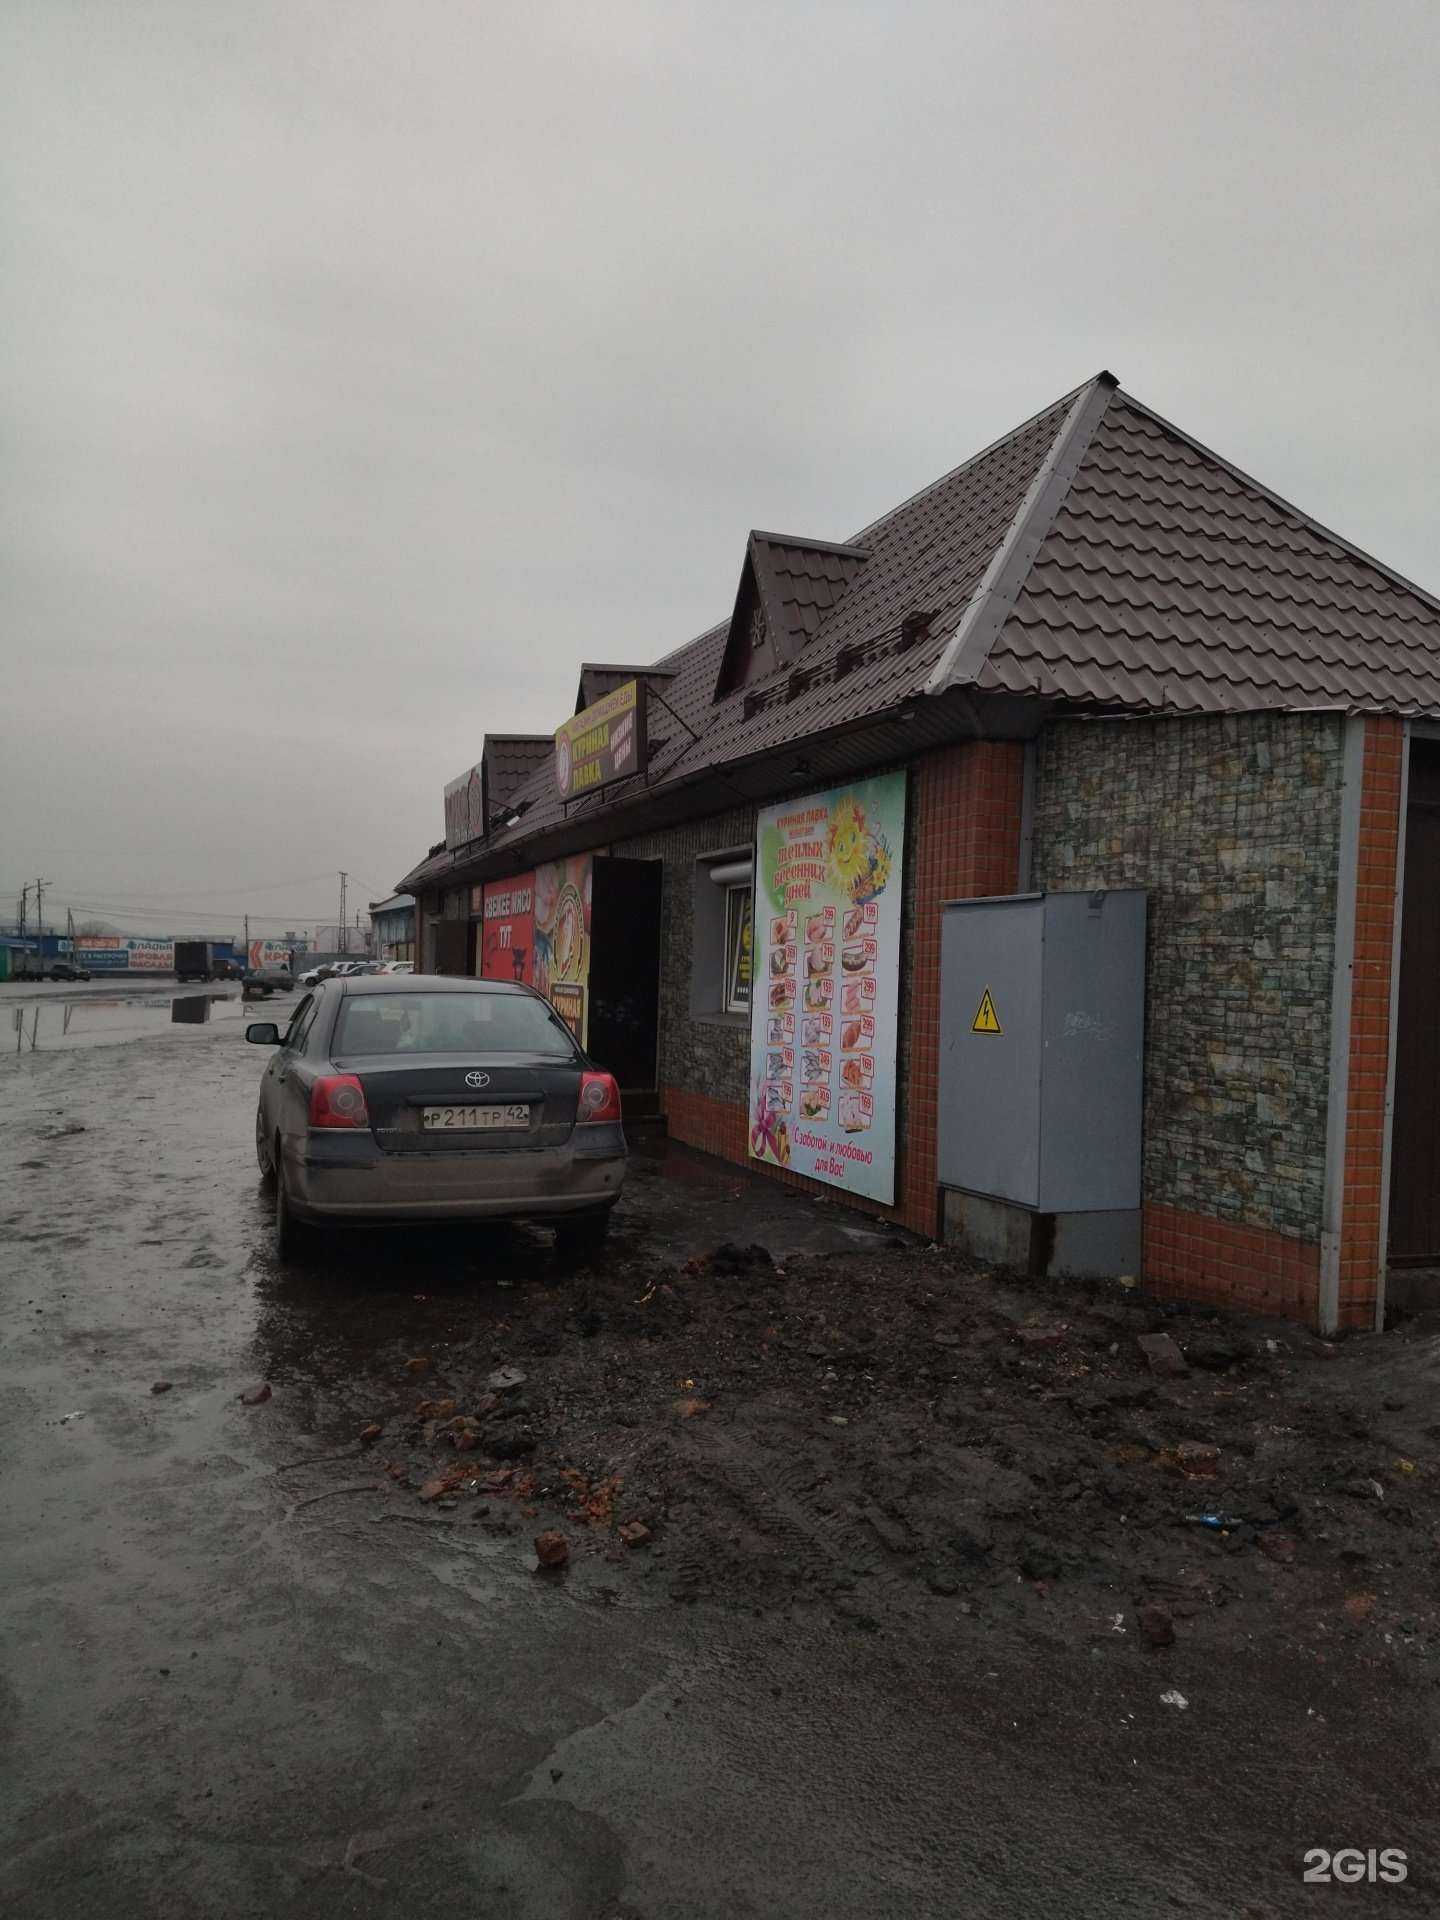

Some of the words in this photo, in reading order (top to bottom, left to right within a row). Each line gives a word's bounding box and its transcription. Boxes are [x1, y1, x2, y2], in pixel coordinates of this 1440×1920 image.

[573, 722, 608, 763] КУРИНАЯ
[614, 736, 631, 770] ЦЕНЫ
[573, 759, 601, 791] ЛАВКА
[484, 893, 511, 918] СВЕЖЕЕ
[511, 888, 532, 914] МЯСО
[136, 942, 173, 951] ЛАДЬЯ
[499, 925, 513, 949] ТУТ
[794, 1126, 800, 1143] С
[800, 1130, 828, 1152] заботой
[834, 1140, 873, 1164] любовью
[815, 1158, 828, 1173] для
[829, 1157, 845, 1177] Вас!
